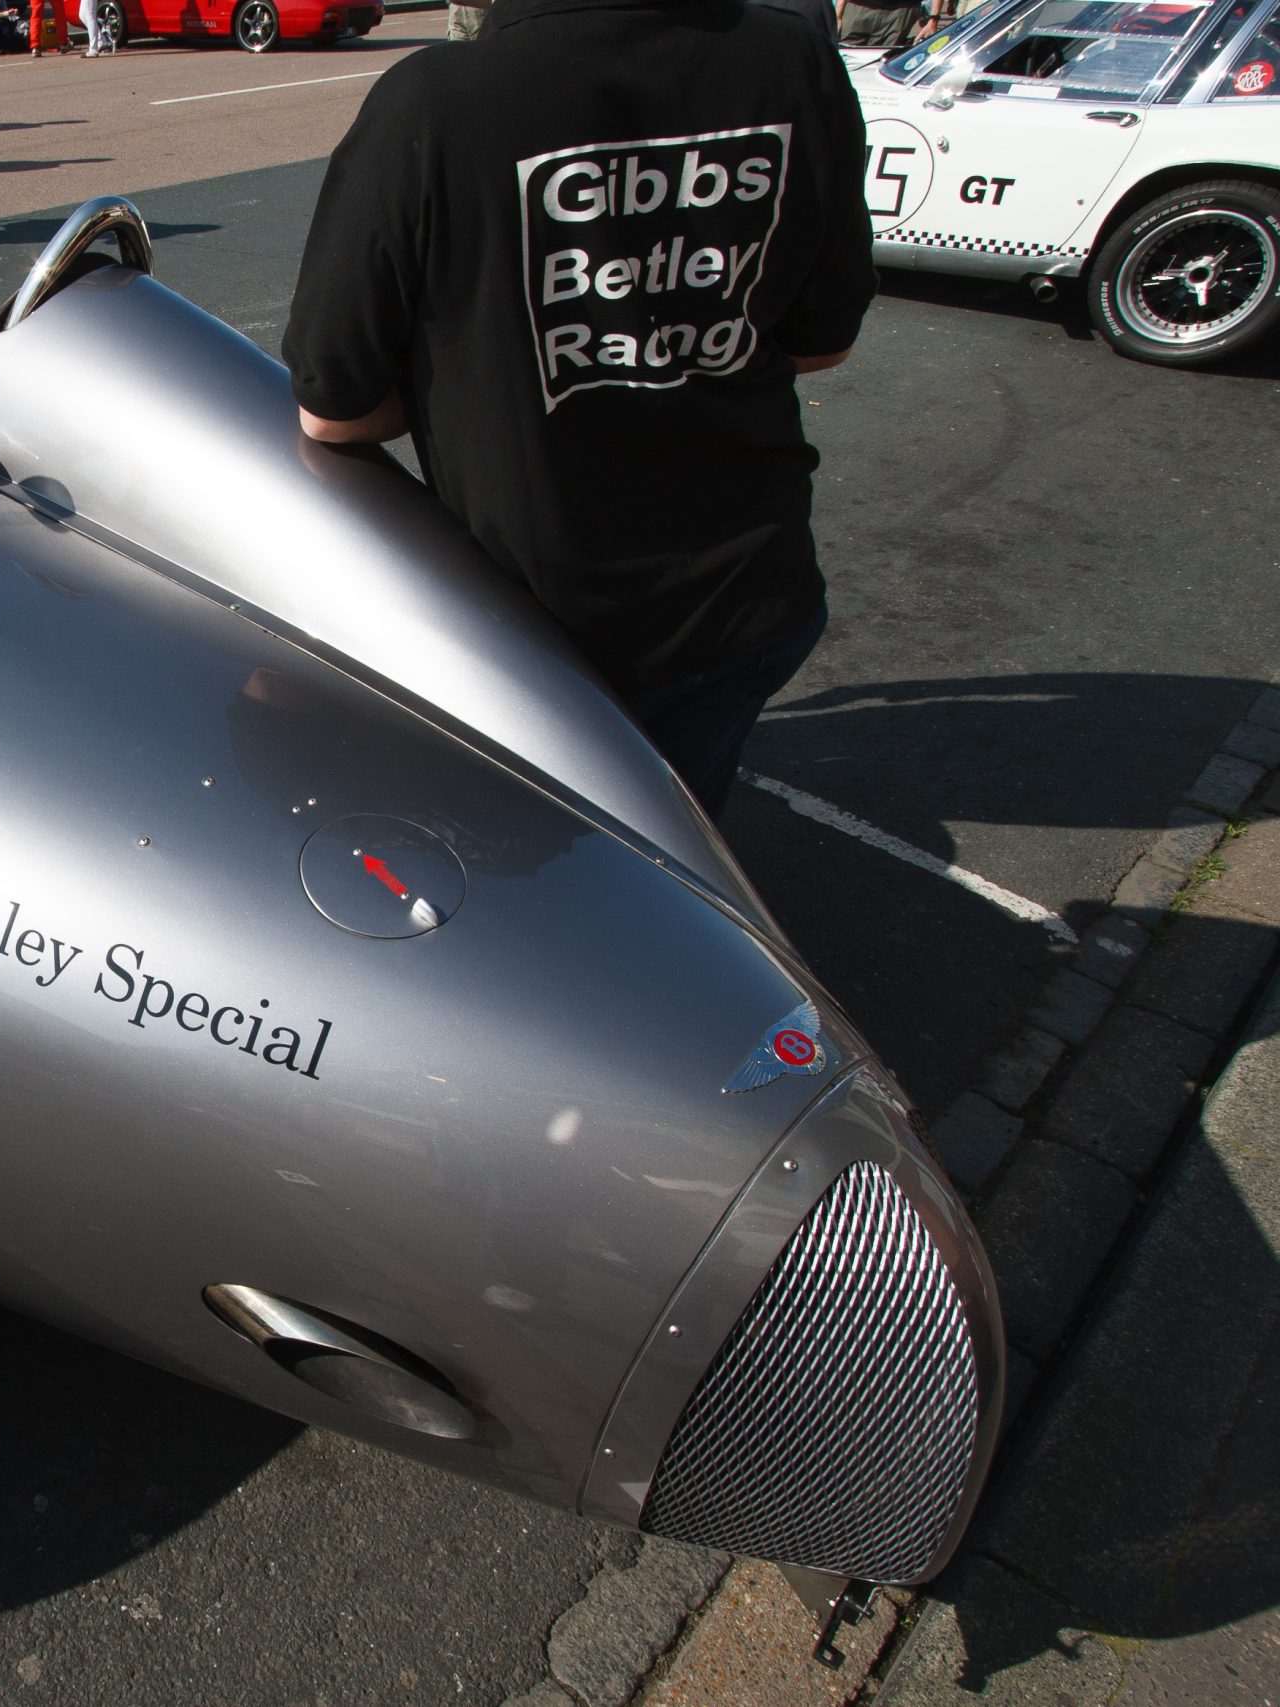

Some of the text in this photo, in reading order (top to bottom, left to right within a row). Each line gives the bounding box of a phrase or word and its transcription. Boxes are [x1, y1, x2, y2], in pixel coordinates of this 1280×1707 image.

[543, 150, 772, 222] Gibbs
[960, 175, 1016, 205] GT
[95, 943, 333, 1080] Special
